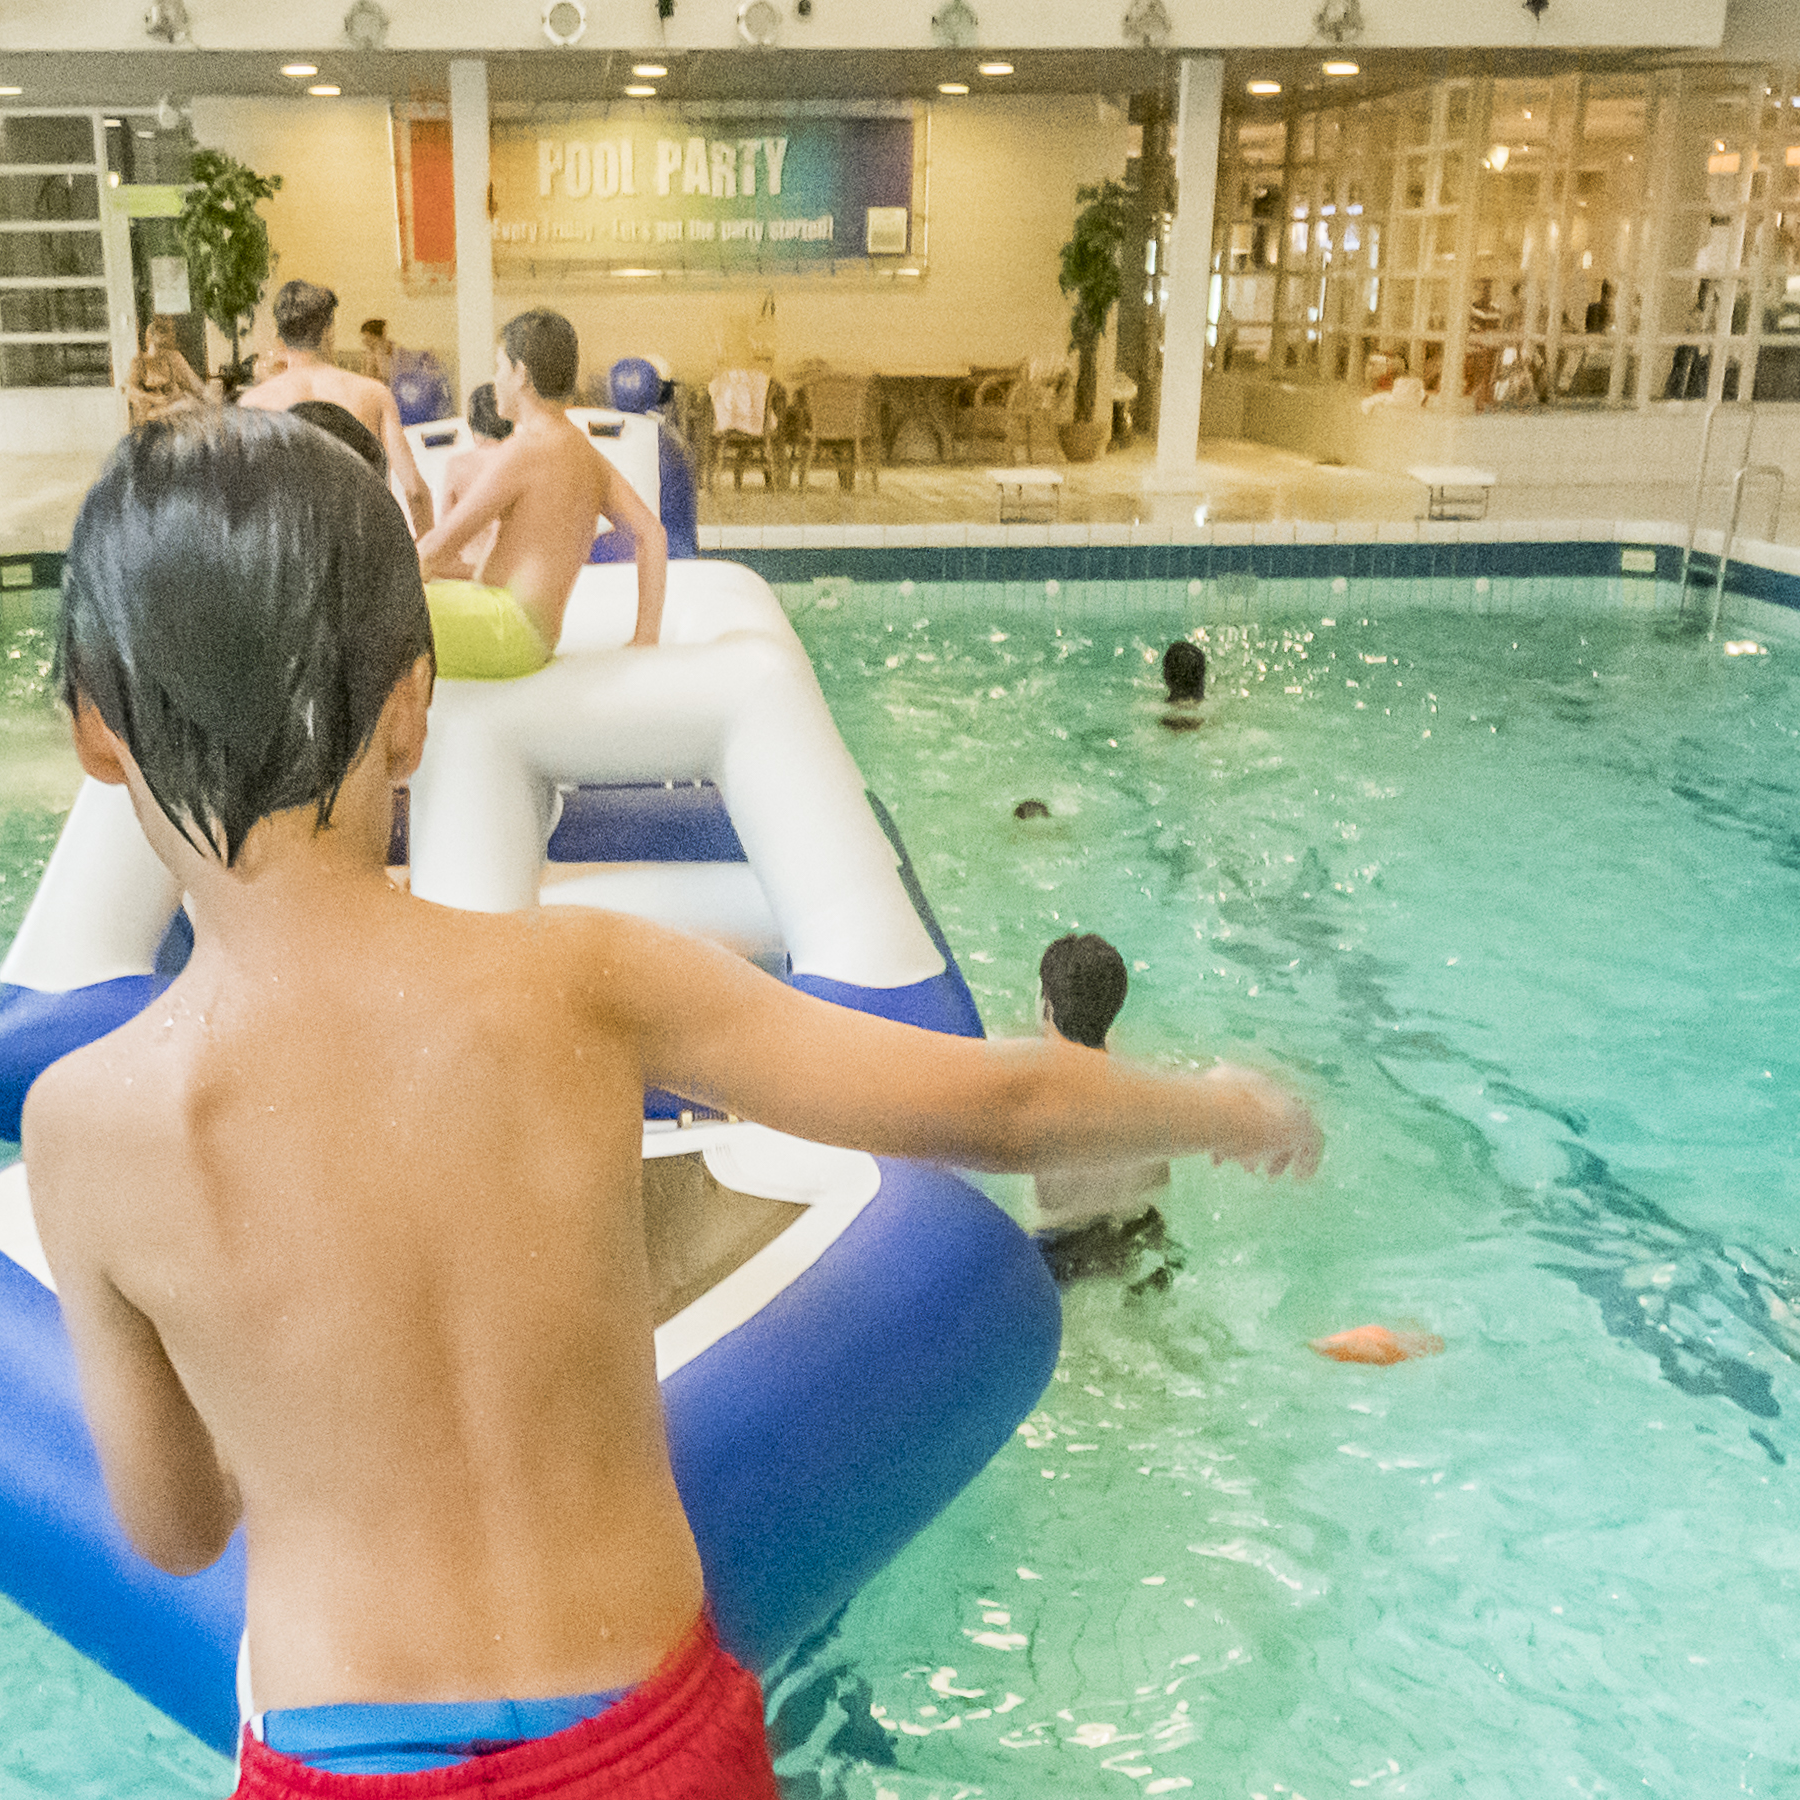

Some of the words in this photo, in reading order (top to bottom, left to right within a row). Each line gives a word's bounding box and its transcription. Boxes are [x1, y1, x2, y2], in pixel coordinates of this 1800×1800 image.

[538, 138, 636, 197] POOL
[656, 137, 789, 197] PARTY
[688, 219, 715, 240] the
[720, 219, 764, 243] party
